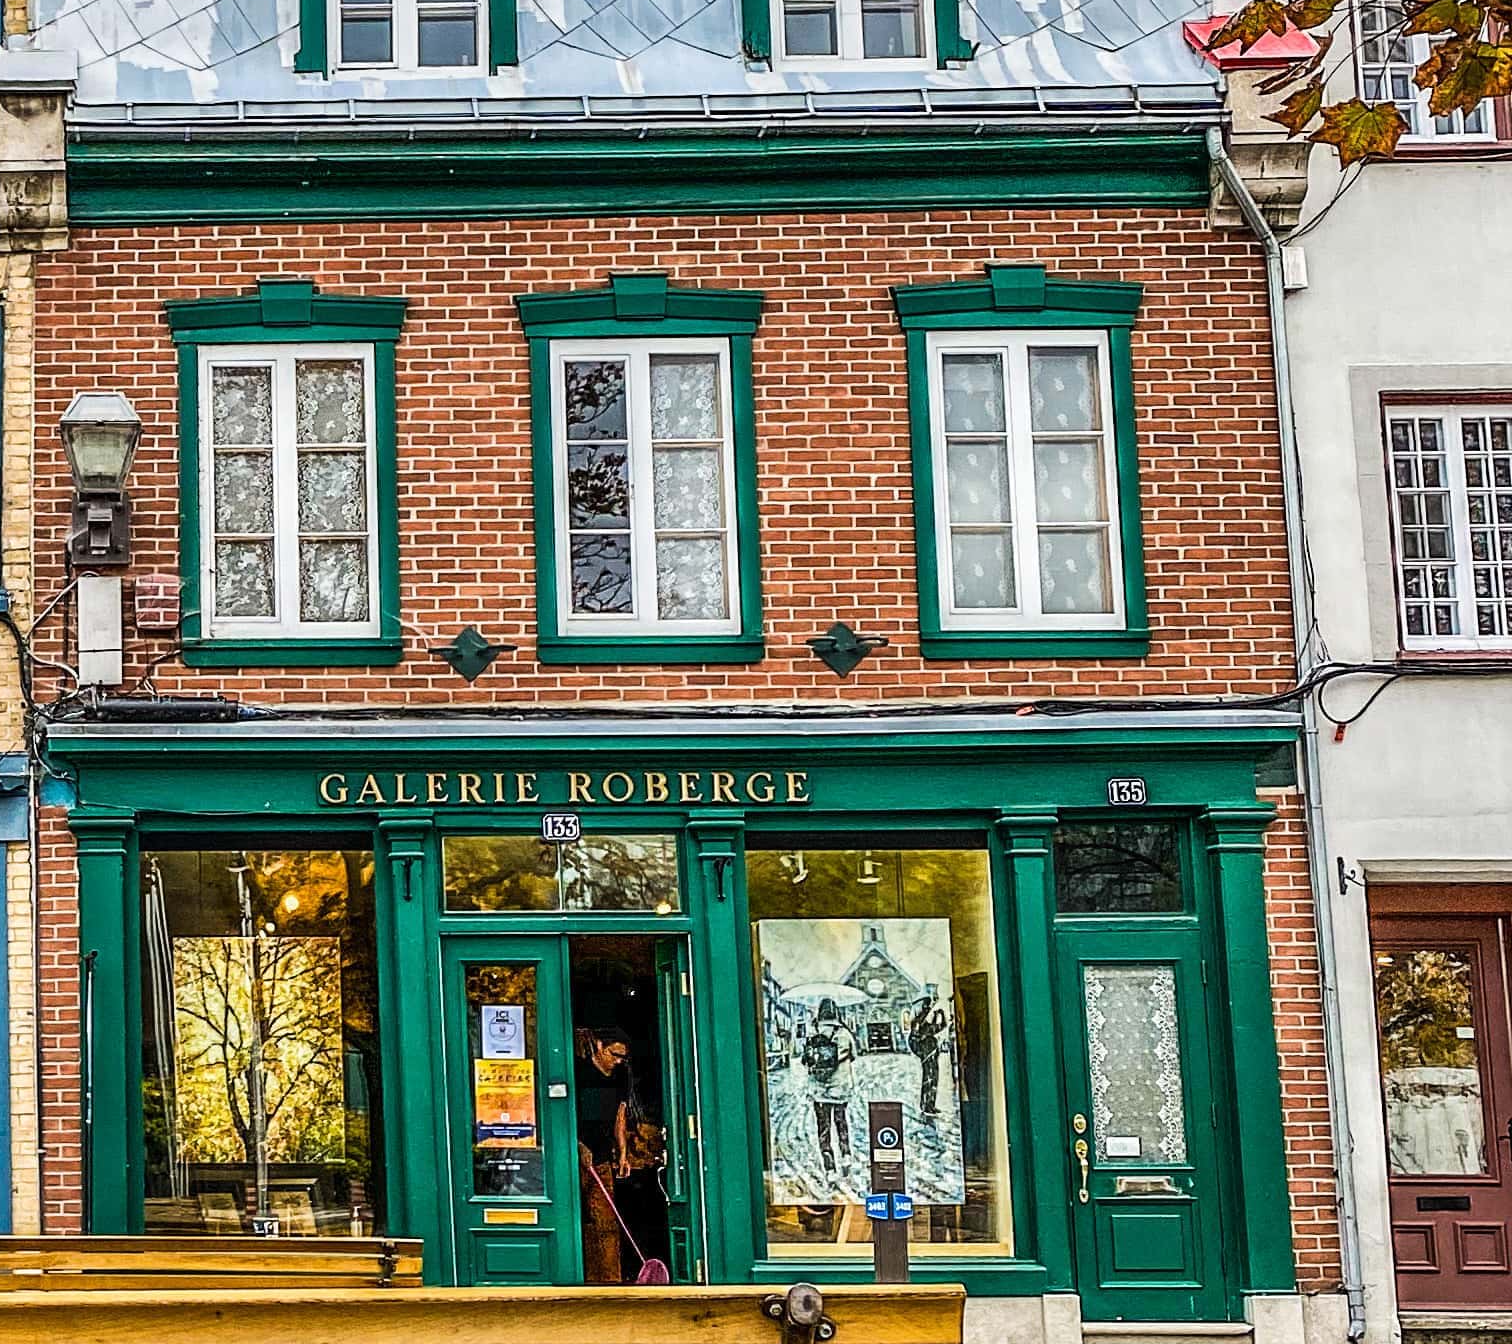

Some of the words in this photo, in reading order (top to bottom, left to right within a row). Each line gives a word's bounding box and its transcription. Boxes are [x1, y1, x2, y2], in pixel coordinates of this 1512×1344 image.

[319, 773, 539, 803] GALERIE
[568, 772, 810, 803] ROBERGE
[1111, 781, 1143, 802] 135
[545, 816, 578, 837] 133
